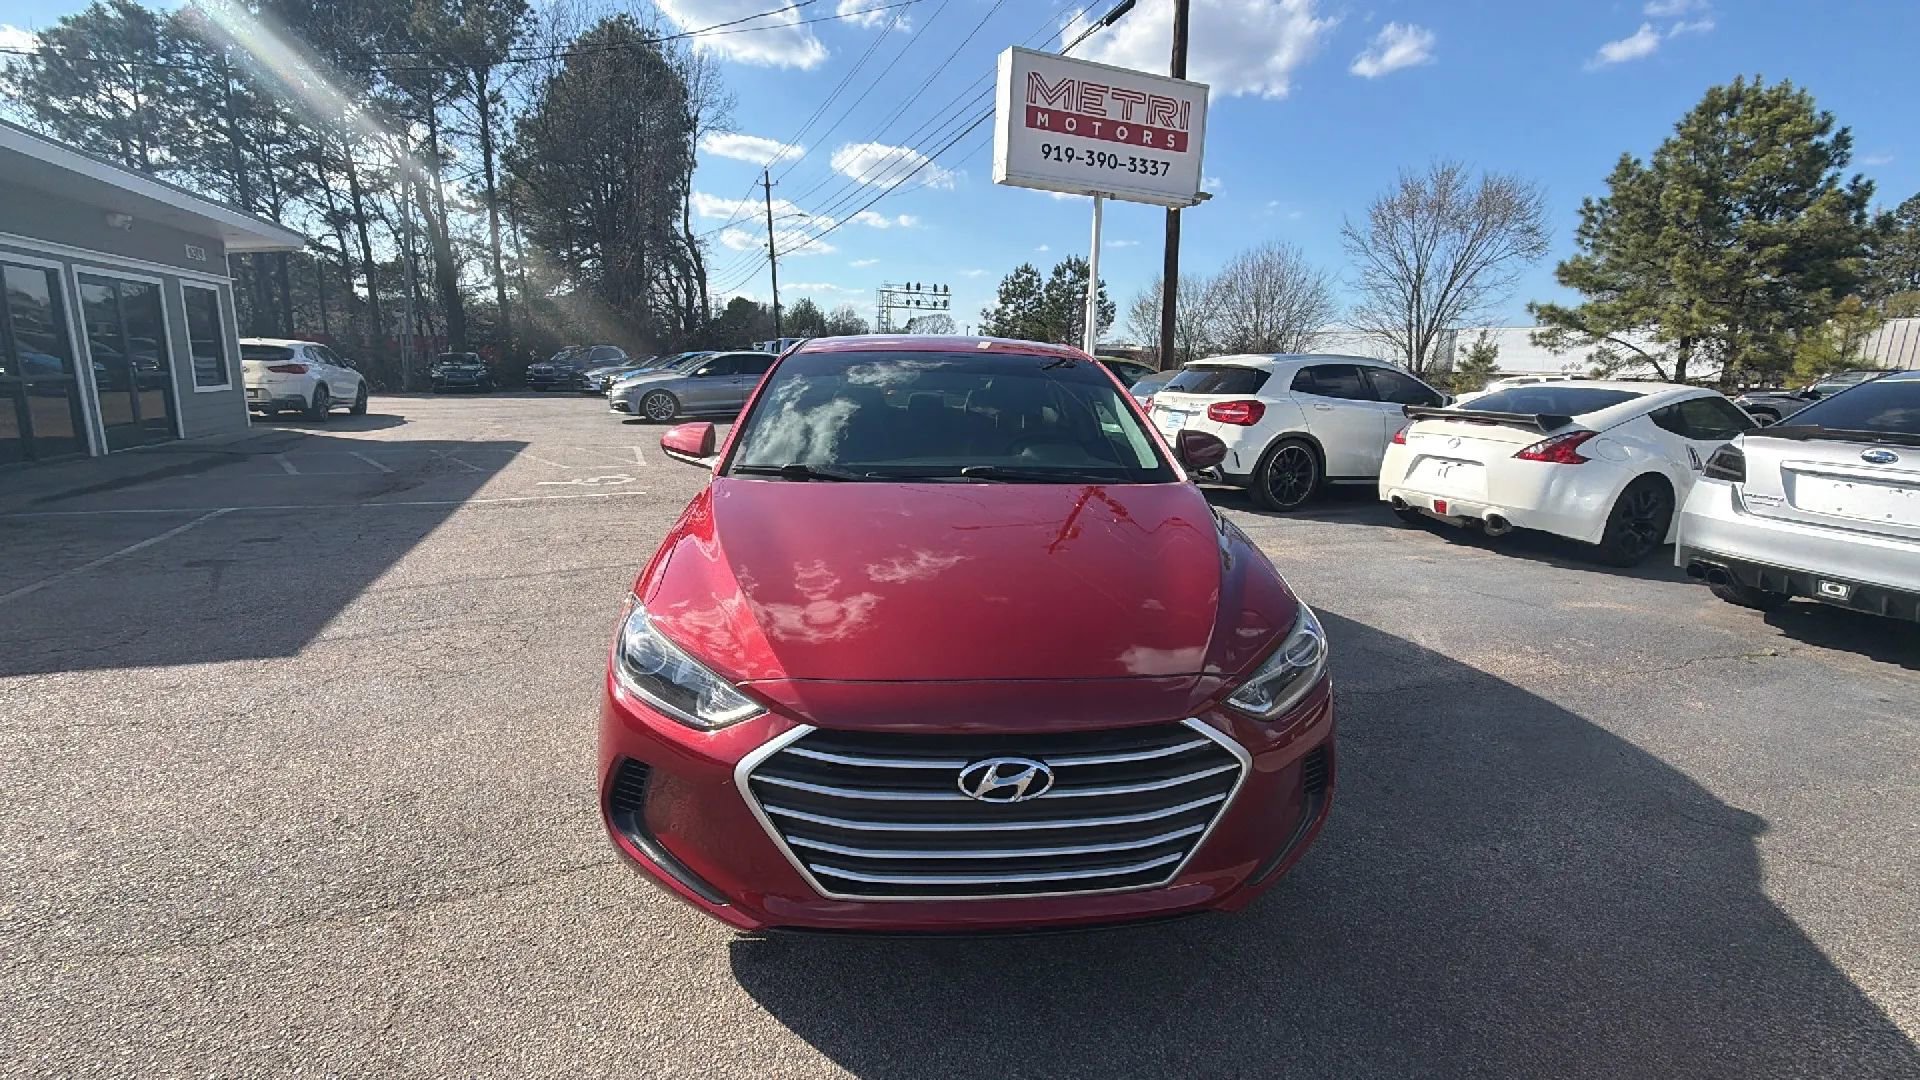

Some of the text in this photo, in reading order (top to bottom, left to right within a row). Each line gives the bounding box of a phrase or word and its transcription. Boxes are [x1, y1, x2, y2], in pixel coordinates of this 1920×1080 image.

[1026, 71, 1191, 130] METRI
[1036, 111, 1176, 148] MOTORS
[1041, 143, 1171, 177] 919-390-3337
